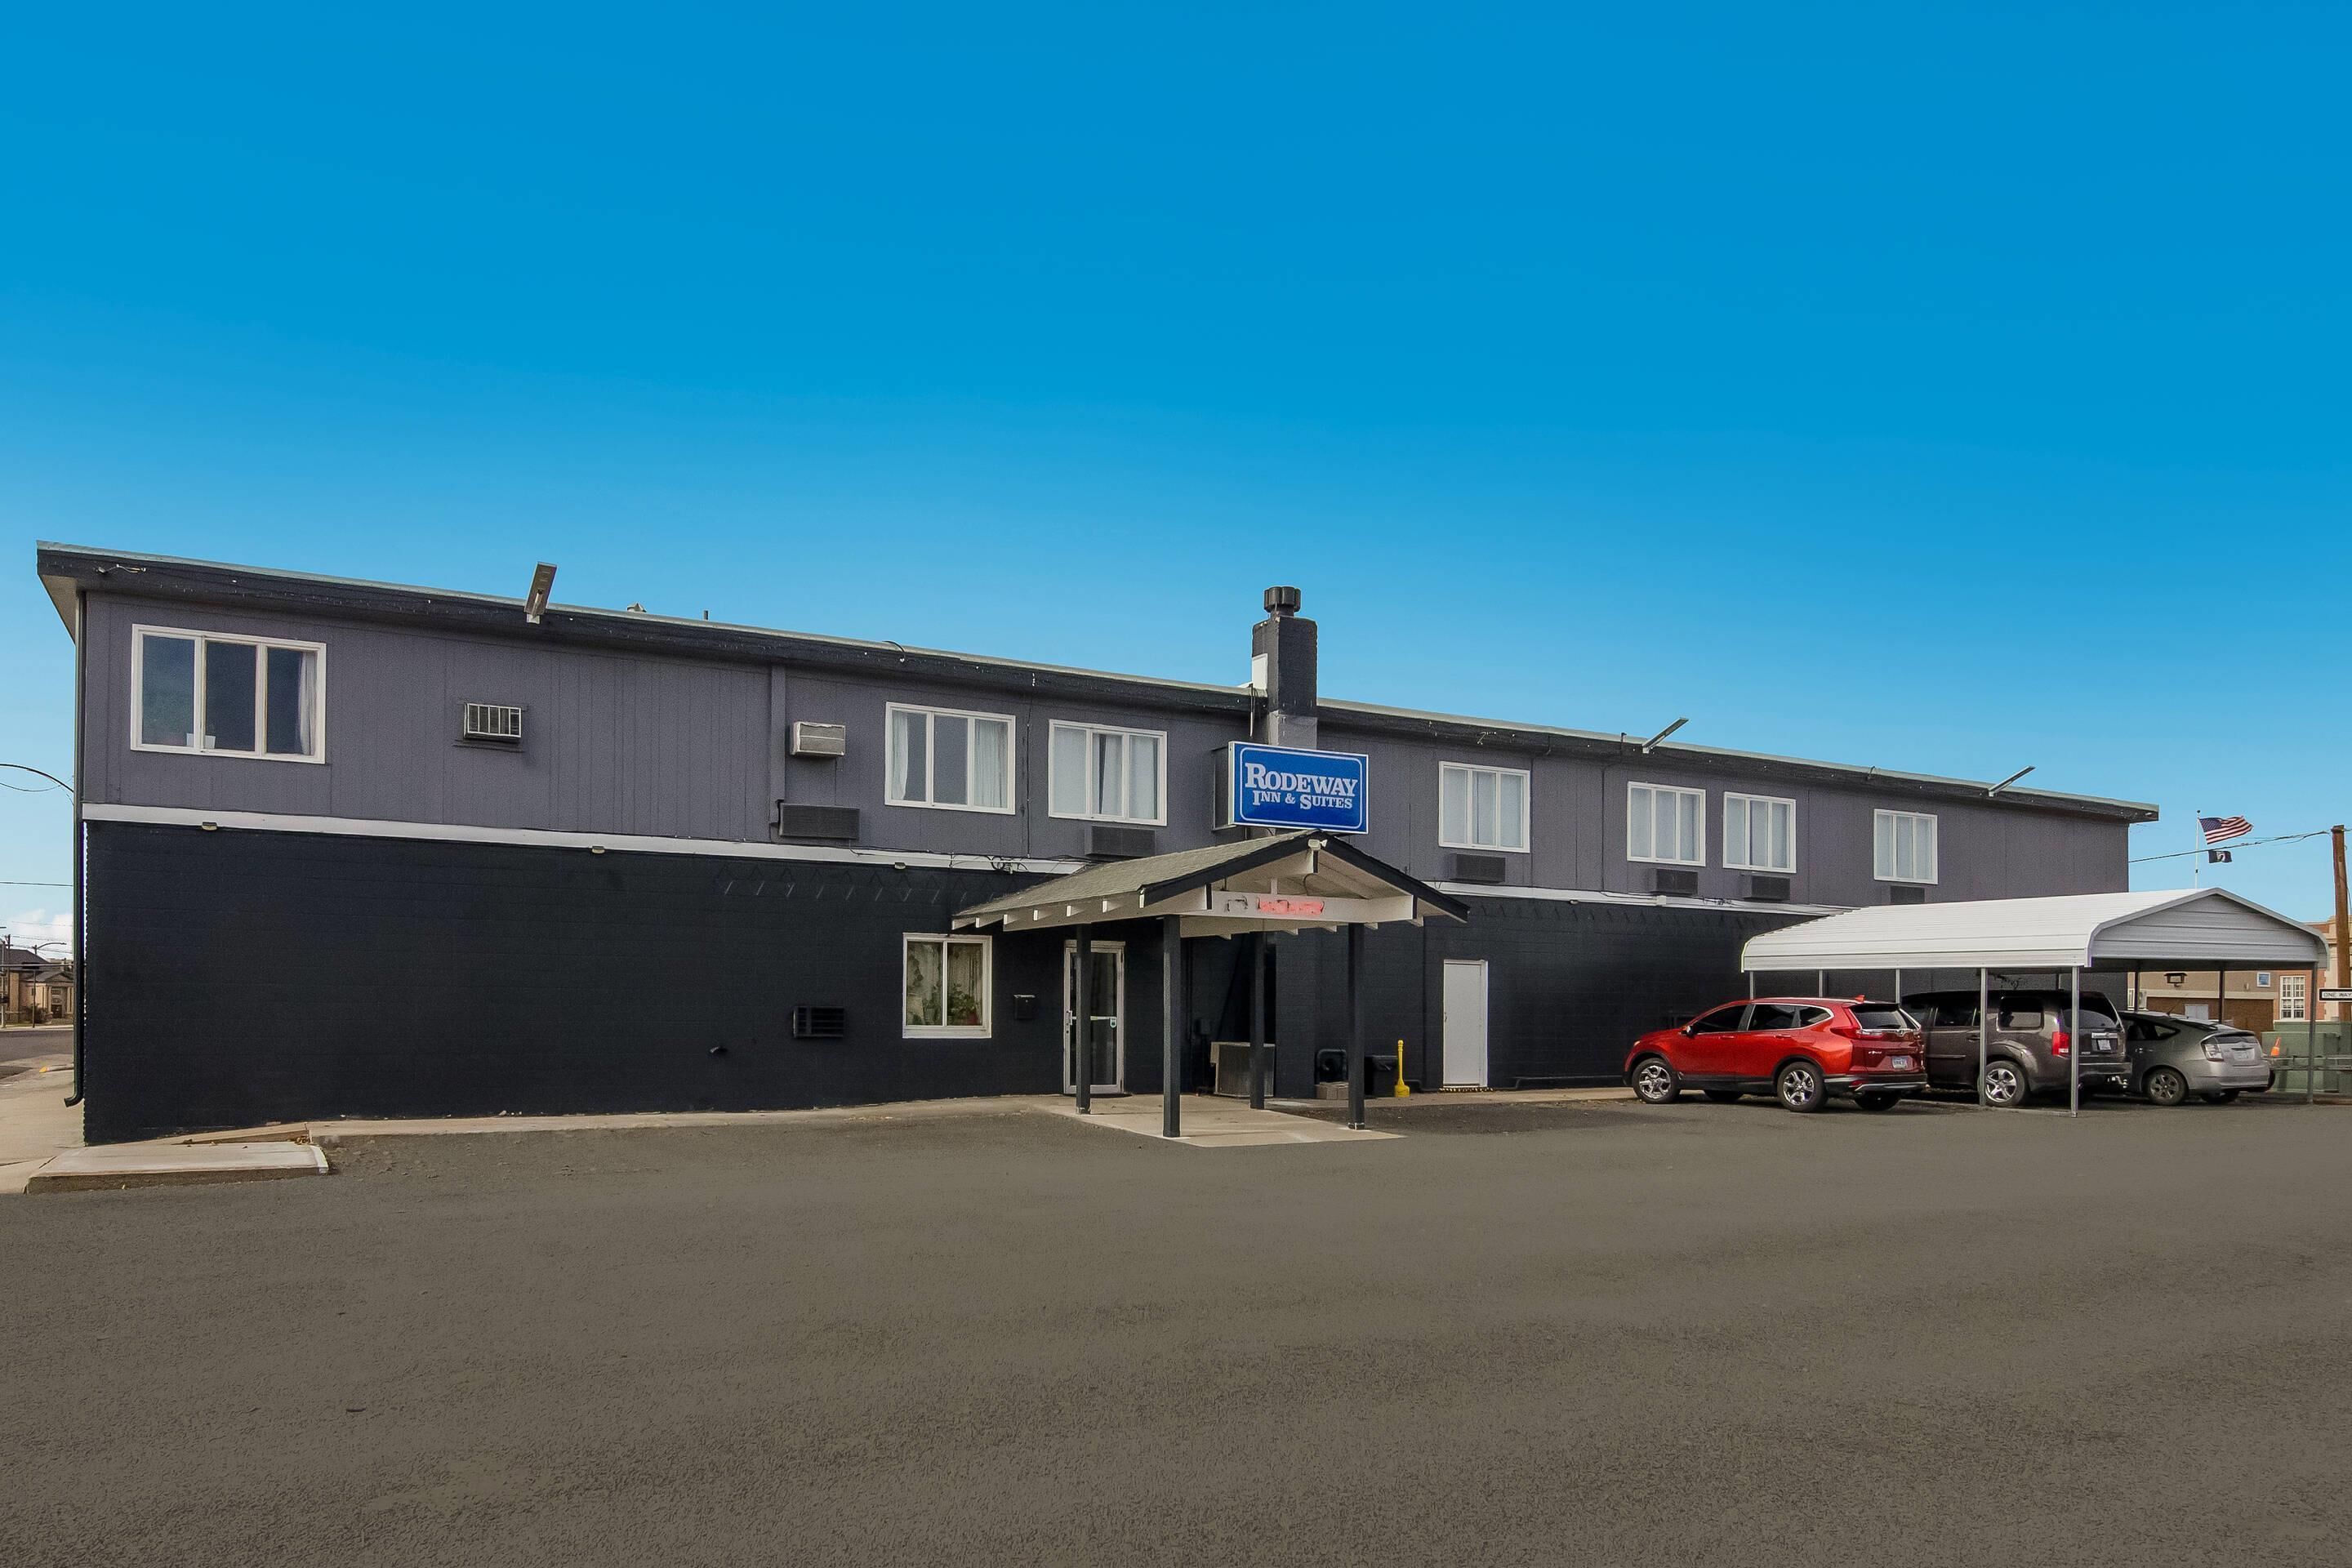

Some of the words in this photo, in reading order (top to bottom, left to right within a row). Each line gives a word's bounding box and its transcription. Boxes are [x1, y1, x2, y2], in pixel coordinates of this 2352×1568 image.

[1245, 763, 1357, 796] RODEWAY
[1253, 790, 1281, 805] INN
[1285, 793, 1295, 804] &
[1299, 794, 1352, 809] SUITES
